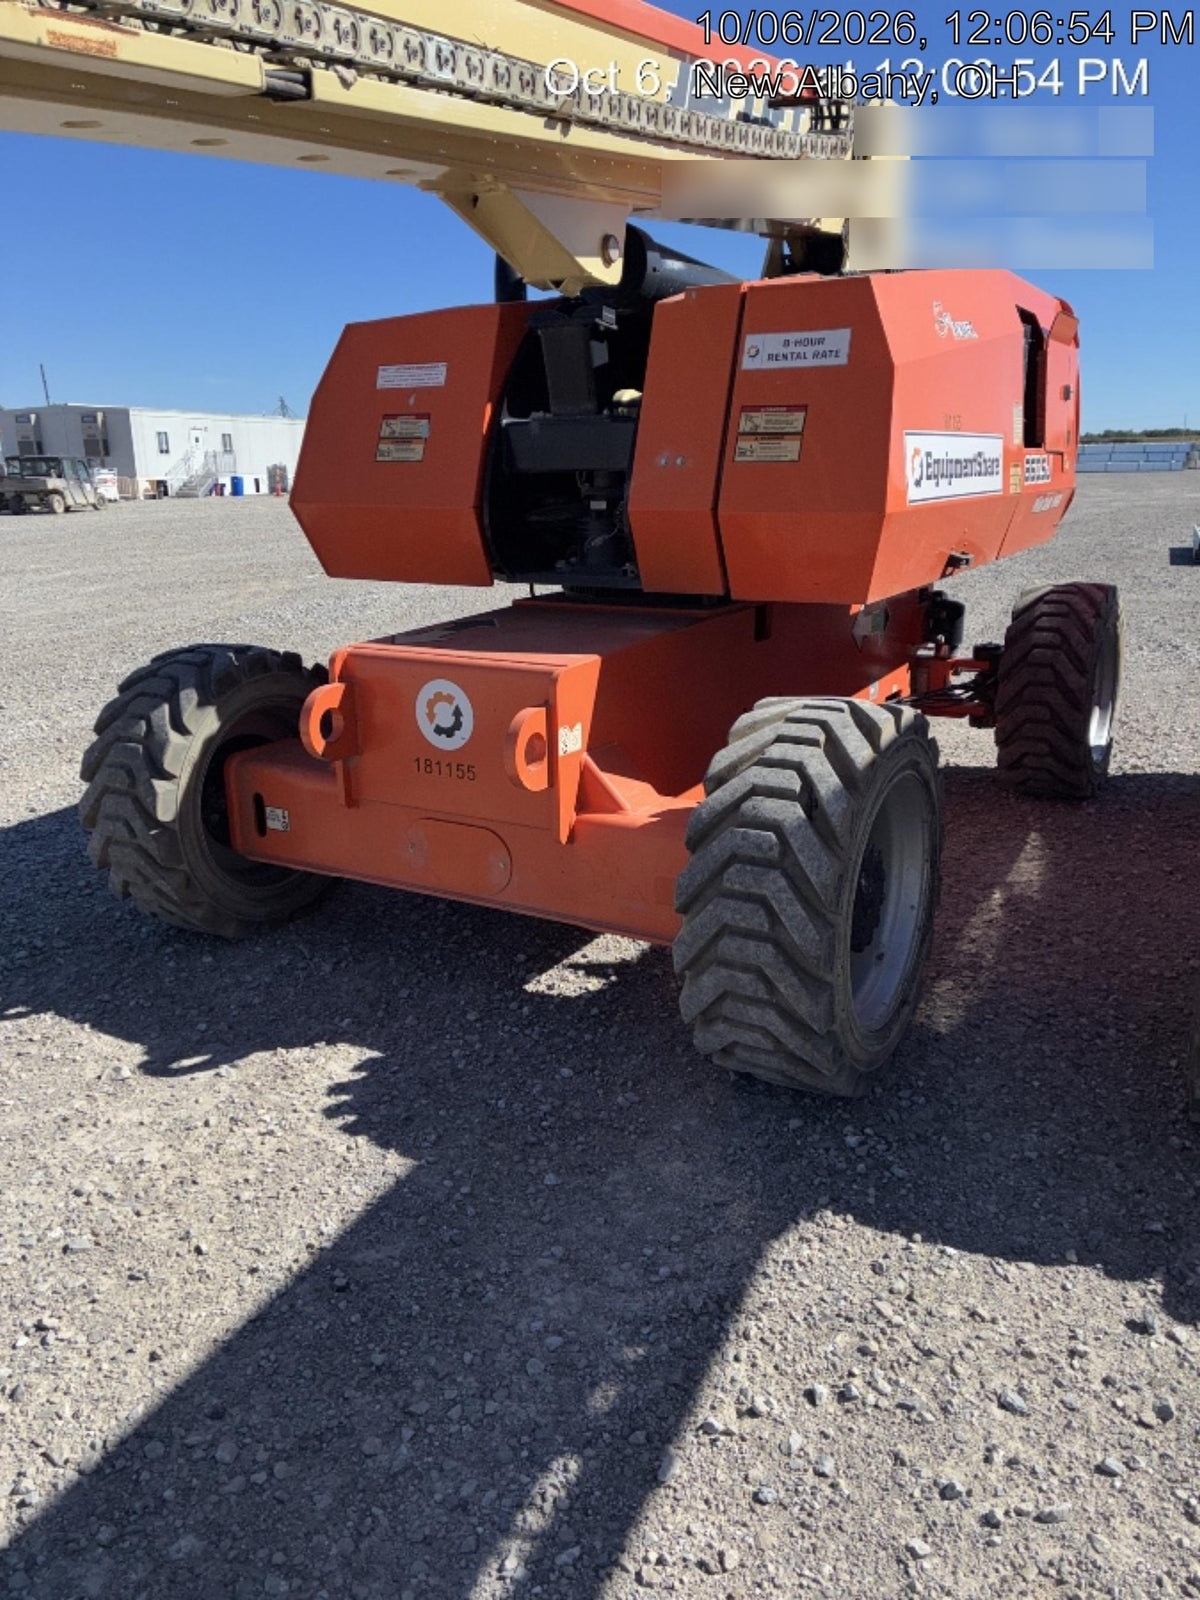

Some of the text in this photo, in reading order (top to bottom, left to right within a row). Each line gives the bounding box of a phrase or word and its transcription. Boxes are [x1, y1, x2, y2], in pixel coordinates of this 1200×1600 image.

[767, 348, 841, 362] RENTAL RATE
[925, 450, 1000, 487] EquipmentShare
[414, 757, 477, 781] 181155
